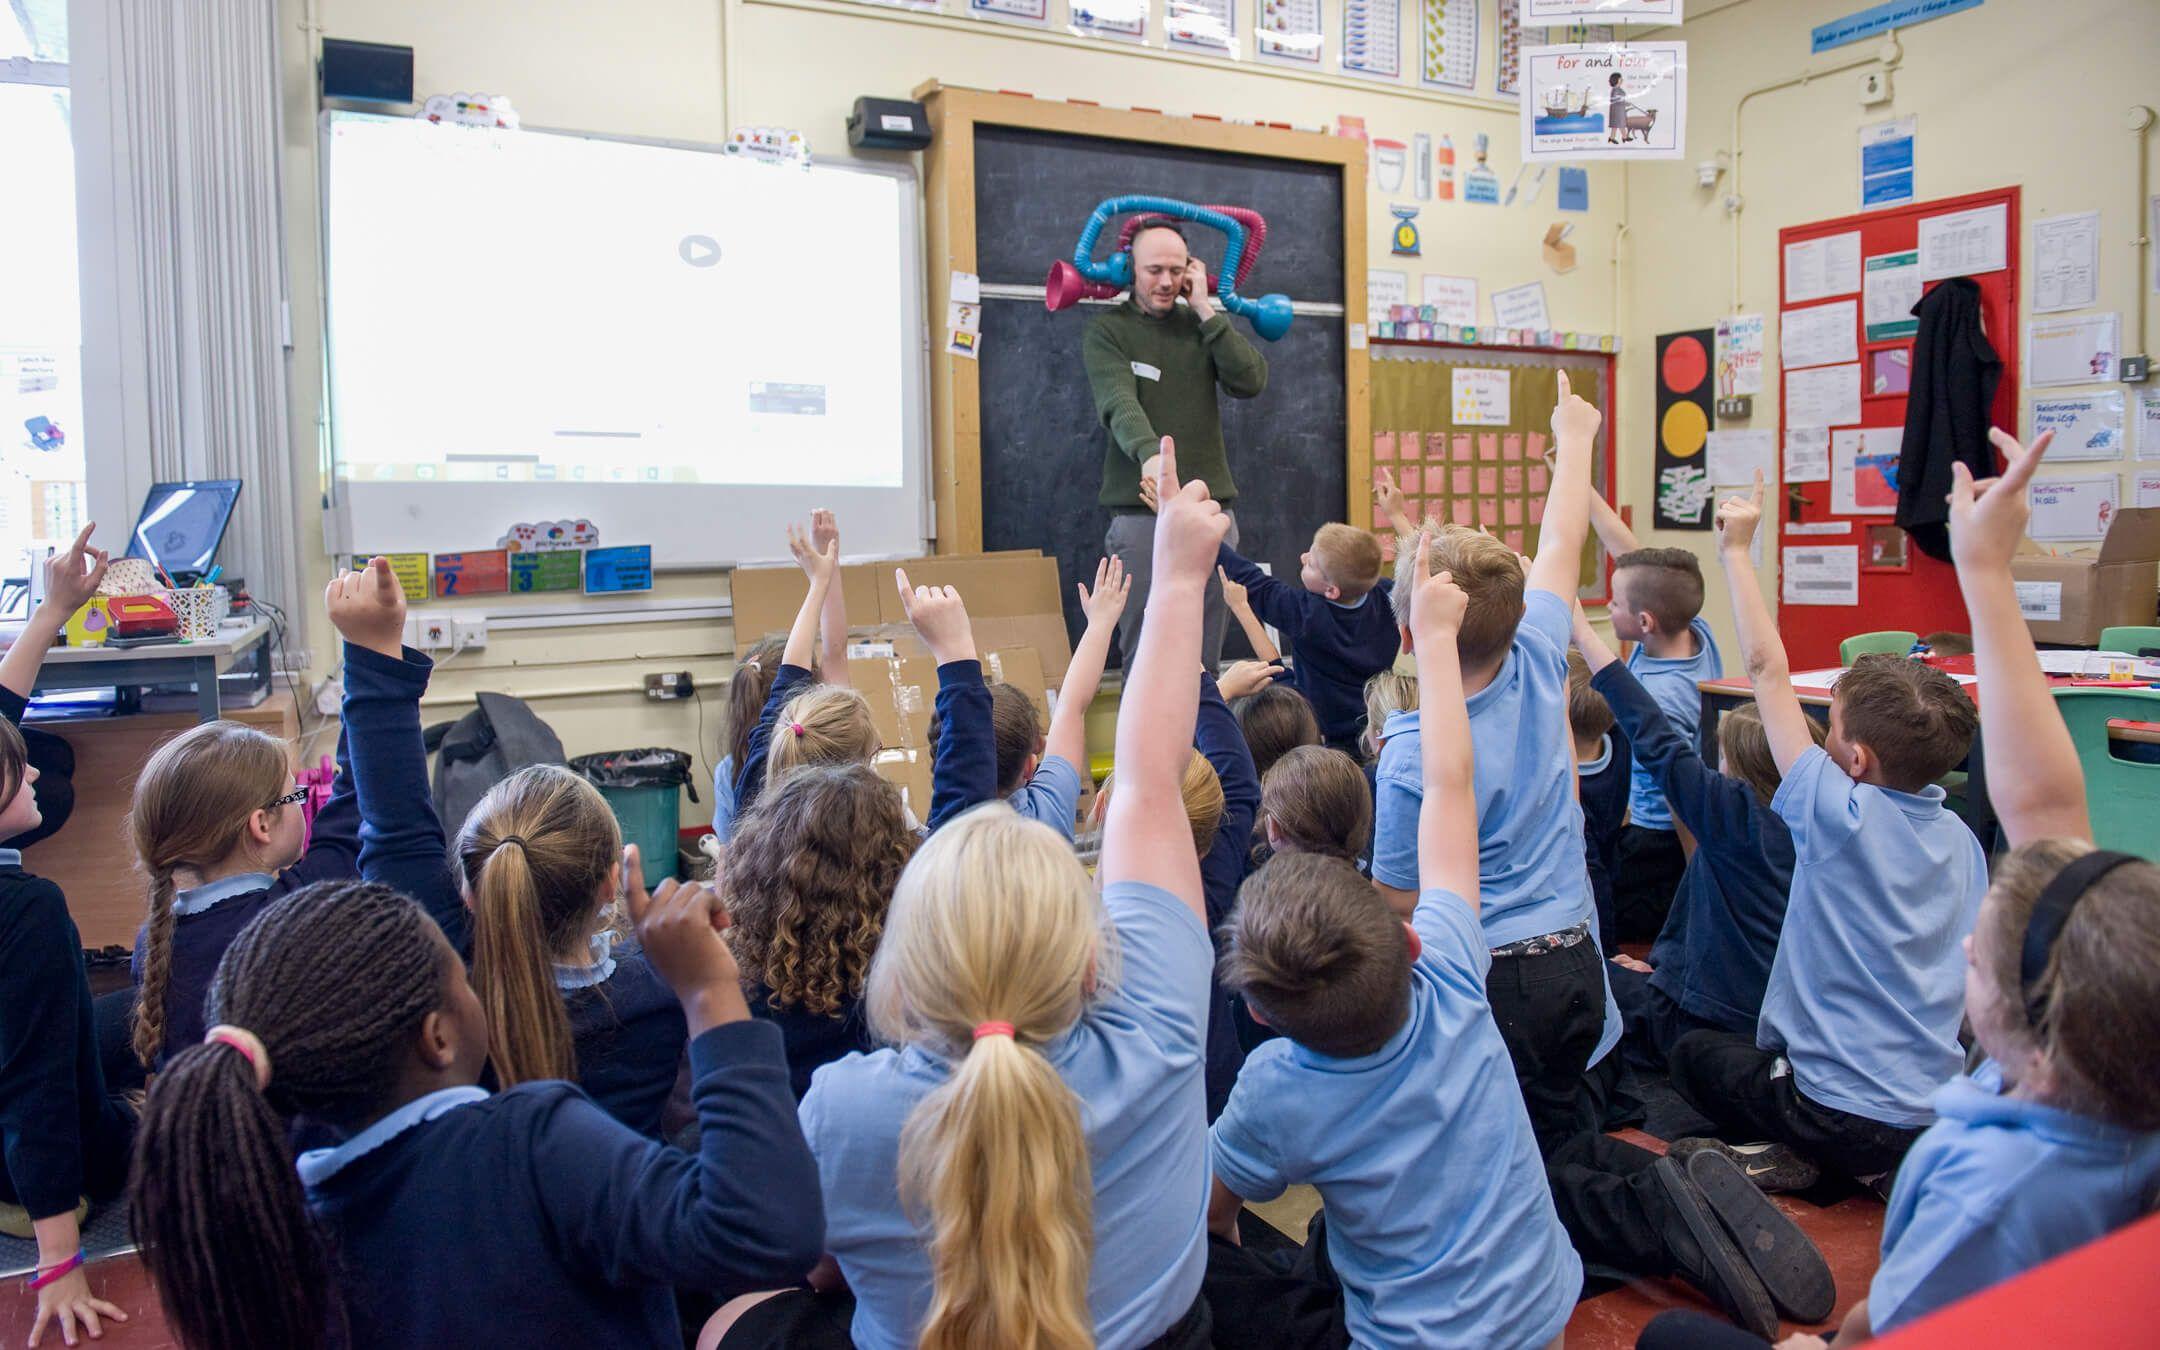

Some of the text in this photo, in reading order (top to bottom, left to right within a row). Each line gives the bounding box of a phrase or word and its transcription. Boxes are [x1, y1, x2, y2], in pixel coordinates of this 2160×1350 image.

[1557, 55, 1581, 70] for
[1585, 55, 1612, 68] and
[2036, 402, 2092, 413] Relationships
[2033, 485, 2075, 494] Reflective
[535, 541, 573, 549] pictures
[444, 571, 459, 597] 2
[518, 570, 533, 593] 3
